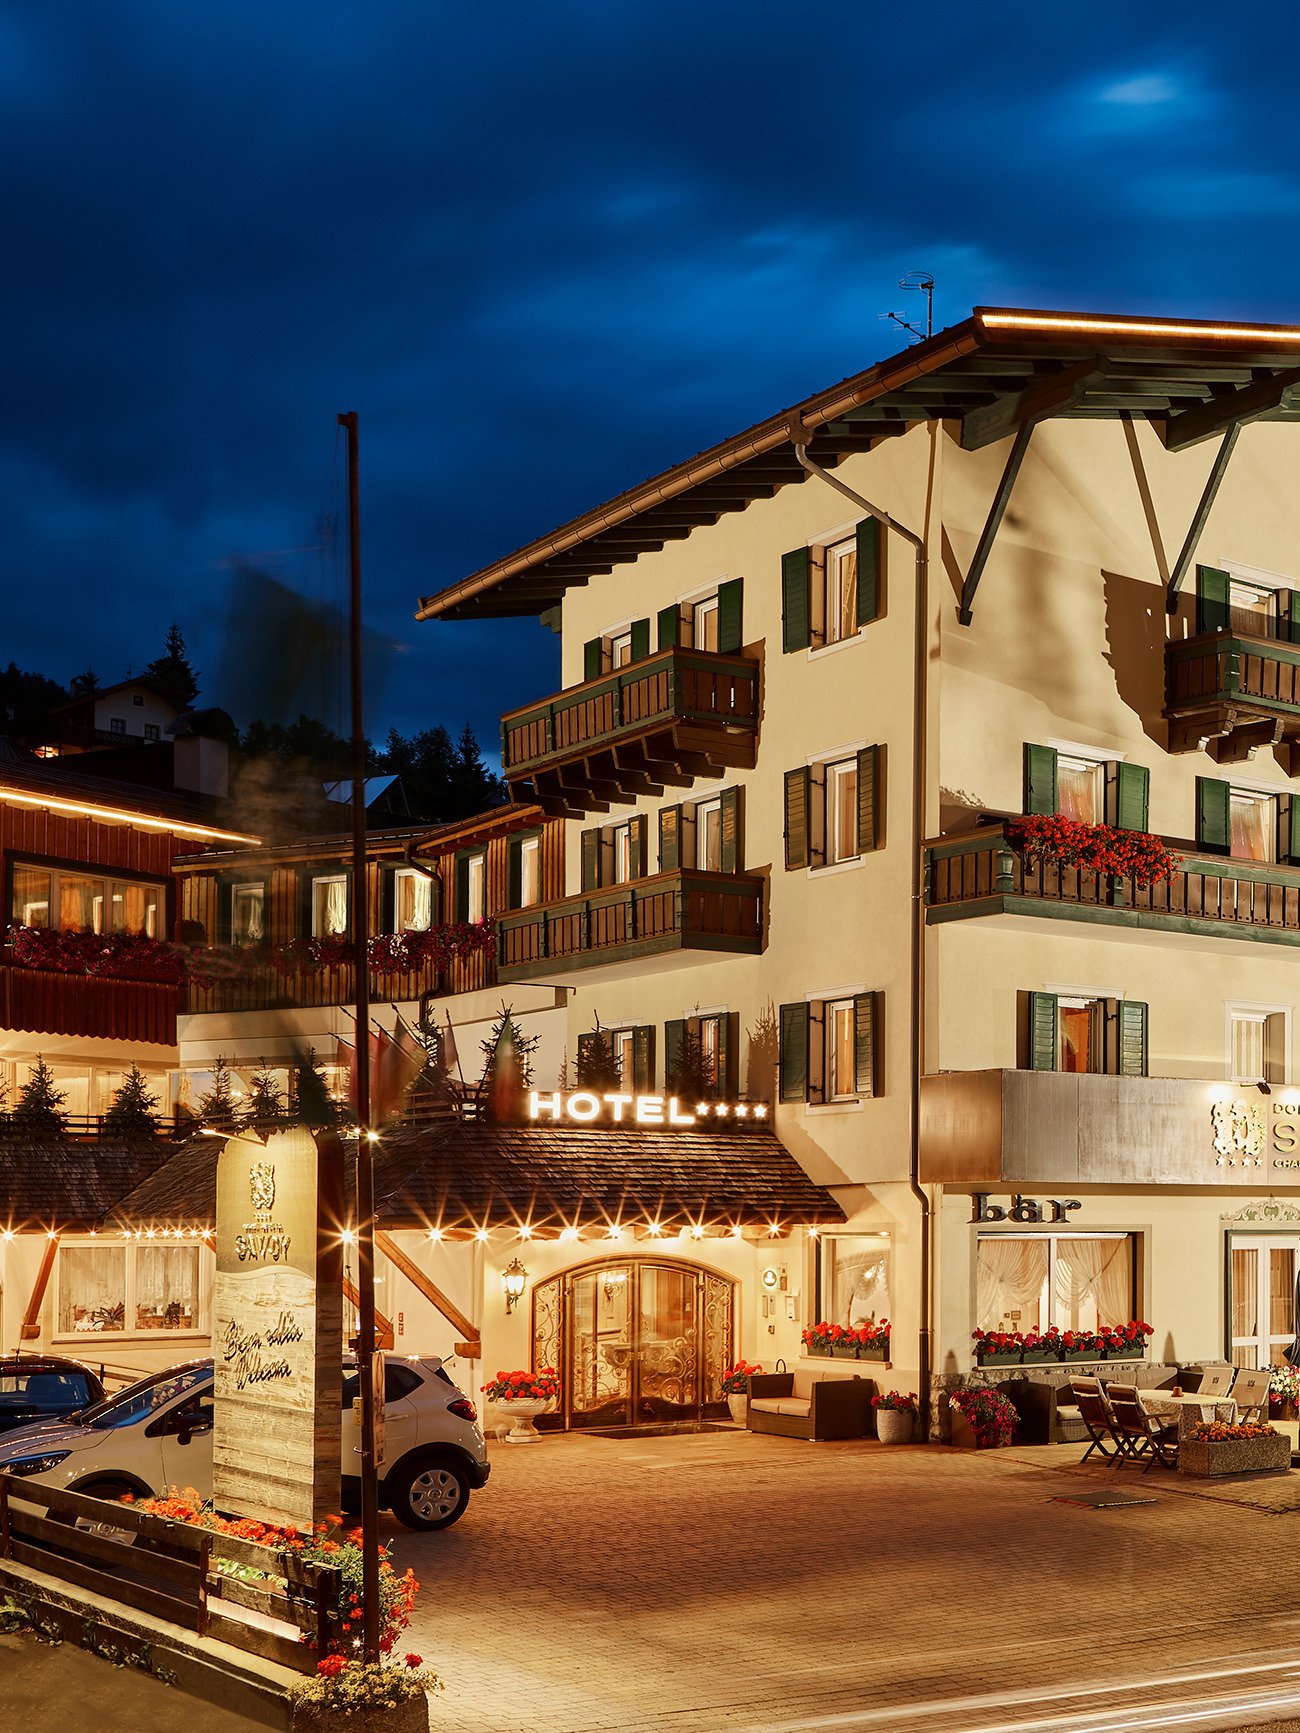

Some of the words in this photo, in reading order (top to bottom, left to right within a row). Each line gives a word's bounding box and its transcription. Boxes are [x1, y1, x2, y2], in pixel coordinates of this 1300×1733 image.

[530, 1091, 695, 1124] HOTEL
[967, 1192, 1081, 1223] bar
[235, 1233, 291, 1261] SAVOY
